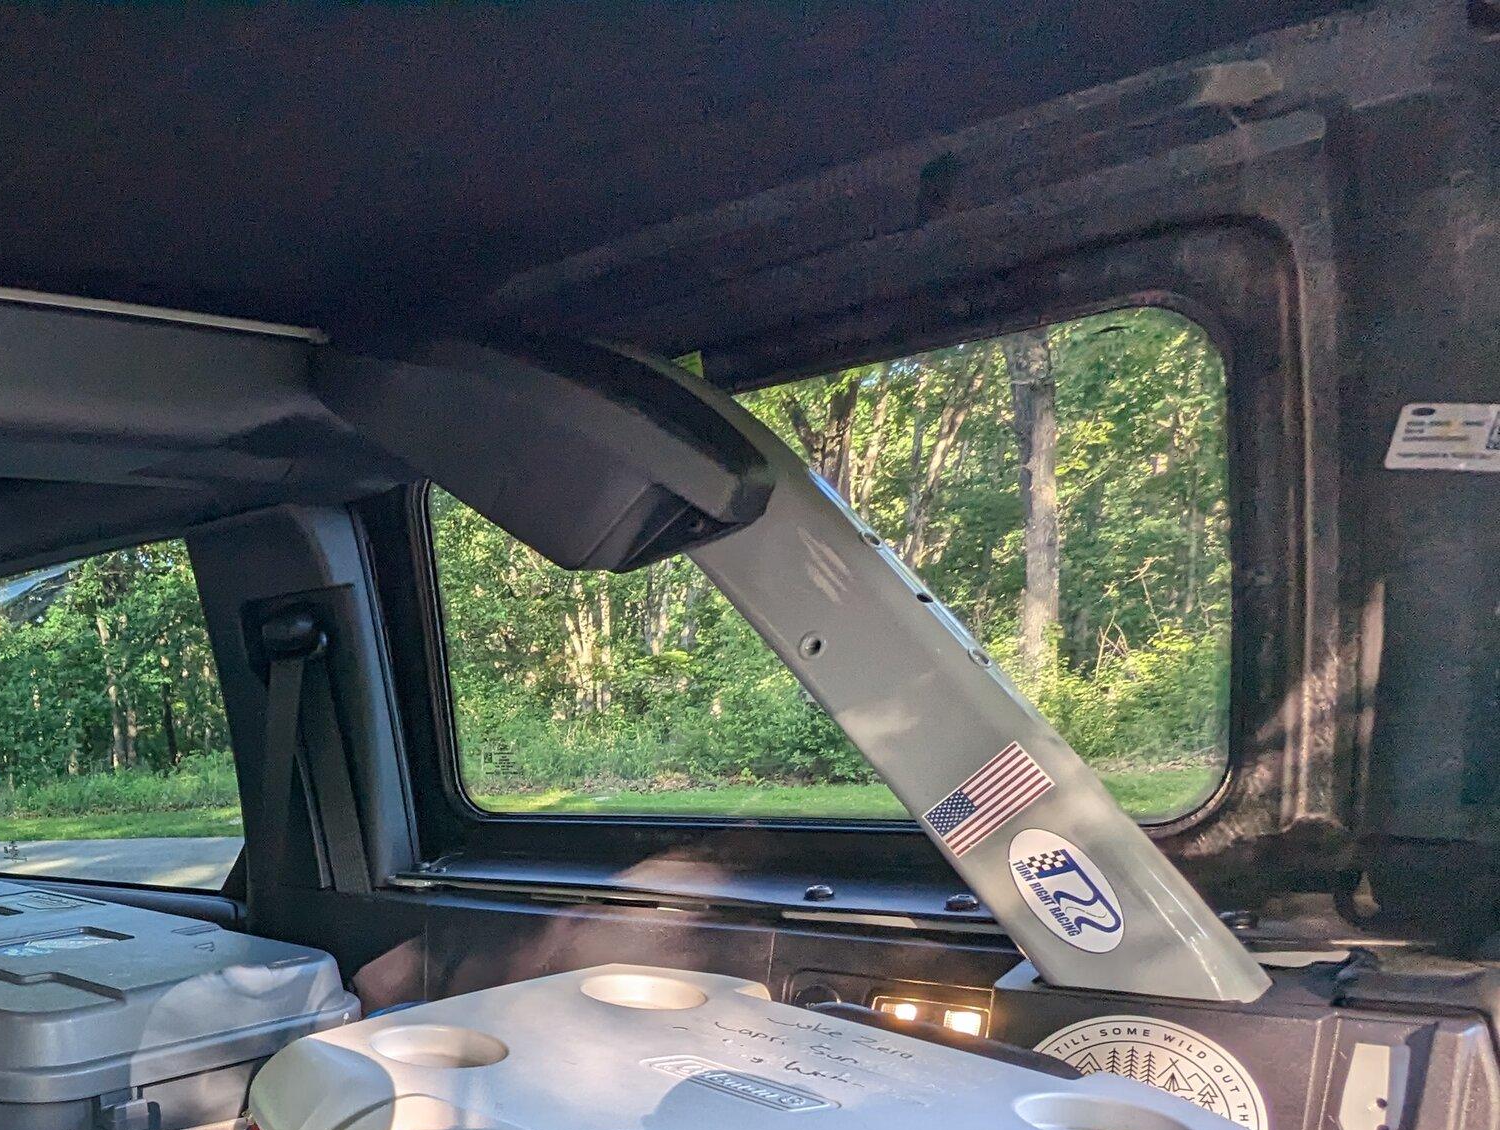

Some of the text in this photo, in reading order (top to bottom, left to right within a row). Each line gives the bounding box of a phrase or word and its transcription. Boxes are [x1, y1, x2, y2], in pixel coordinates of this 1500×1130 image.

[1012, 860, 1081, 937] TURN RIGHT RACING
[1053, 1027, 1250, 1123] TILL SOME WILD OUT TH
